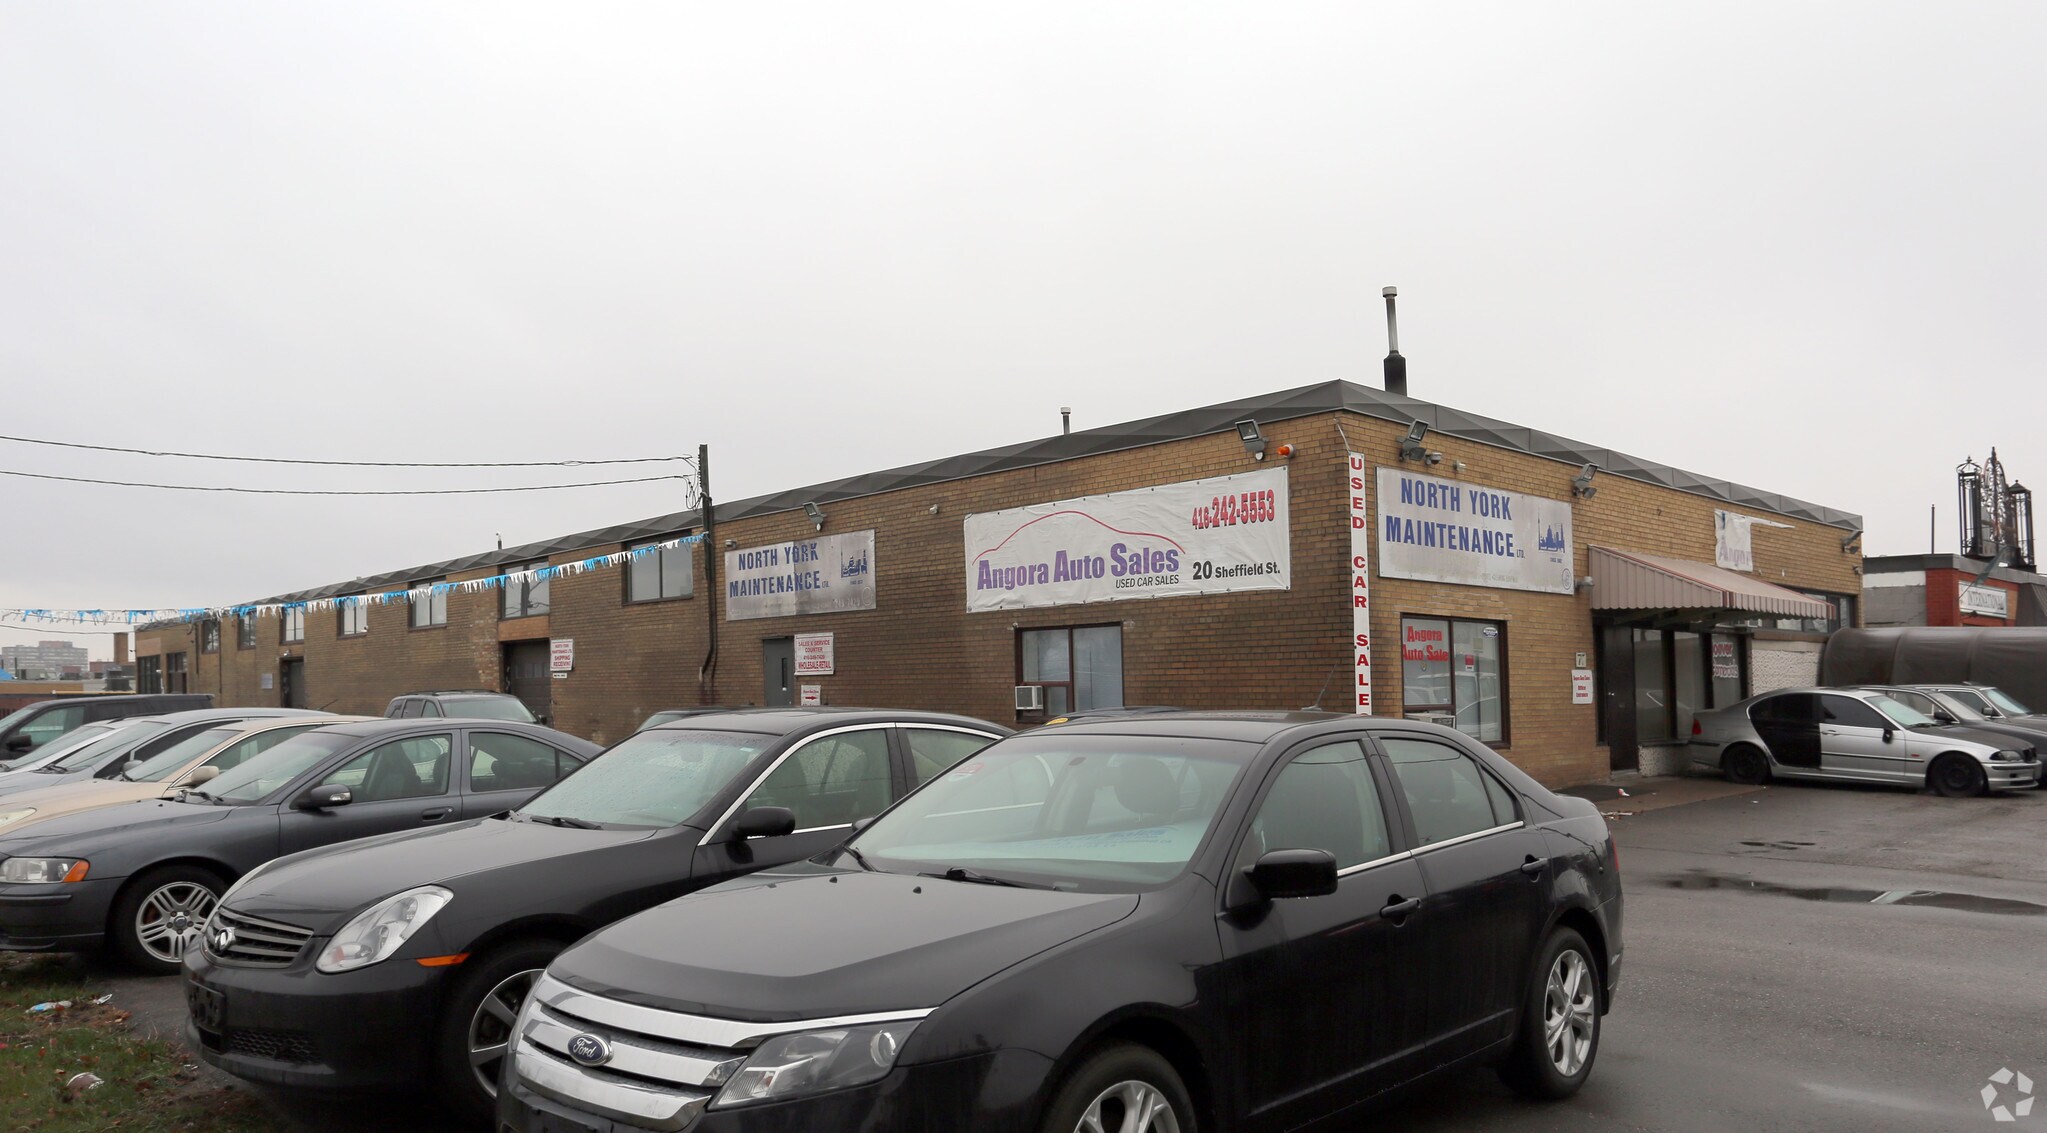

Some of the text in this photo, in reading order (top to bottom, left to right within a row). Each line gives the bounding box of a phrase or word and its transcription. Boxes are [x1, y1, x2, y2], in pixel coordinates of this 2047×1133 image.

[1192, 489, 1275, 530] 416-242-5553
[1401, 478, 1512, 520] NORTH YORK
[1386, 515, 1515, 558] MAINTENANCE
[738, 543, 819, 571] NORTH YORK
[977, 542, 1180, 591] Angora Auto Sales
[1192, 560, 1281, 580] 20 Sheffield St.
[729, 571, 821, 598] MAINTENANCE
[1115, 574, 1180, 589] USED CAR SALES
[1350, 457, 1370, 716] USED CAR SALE
[1407, 626, 1443, 642] Angora
[1402, 643, 1449, 662] Auto Sale
[573, 1037, 597, 1058] Ford
